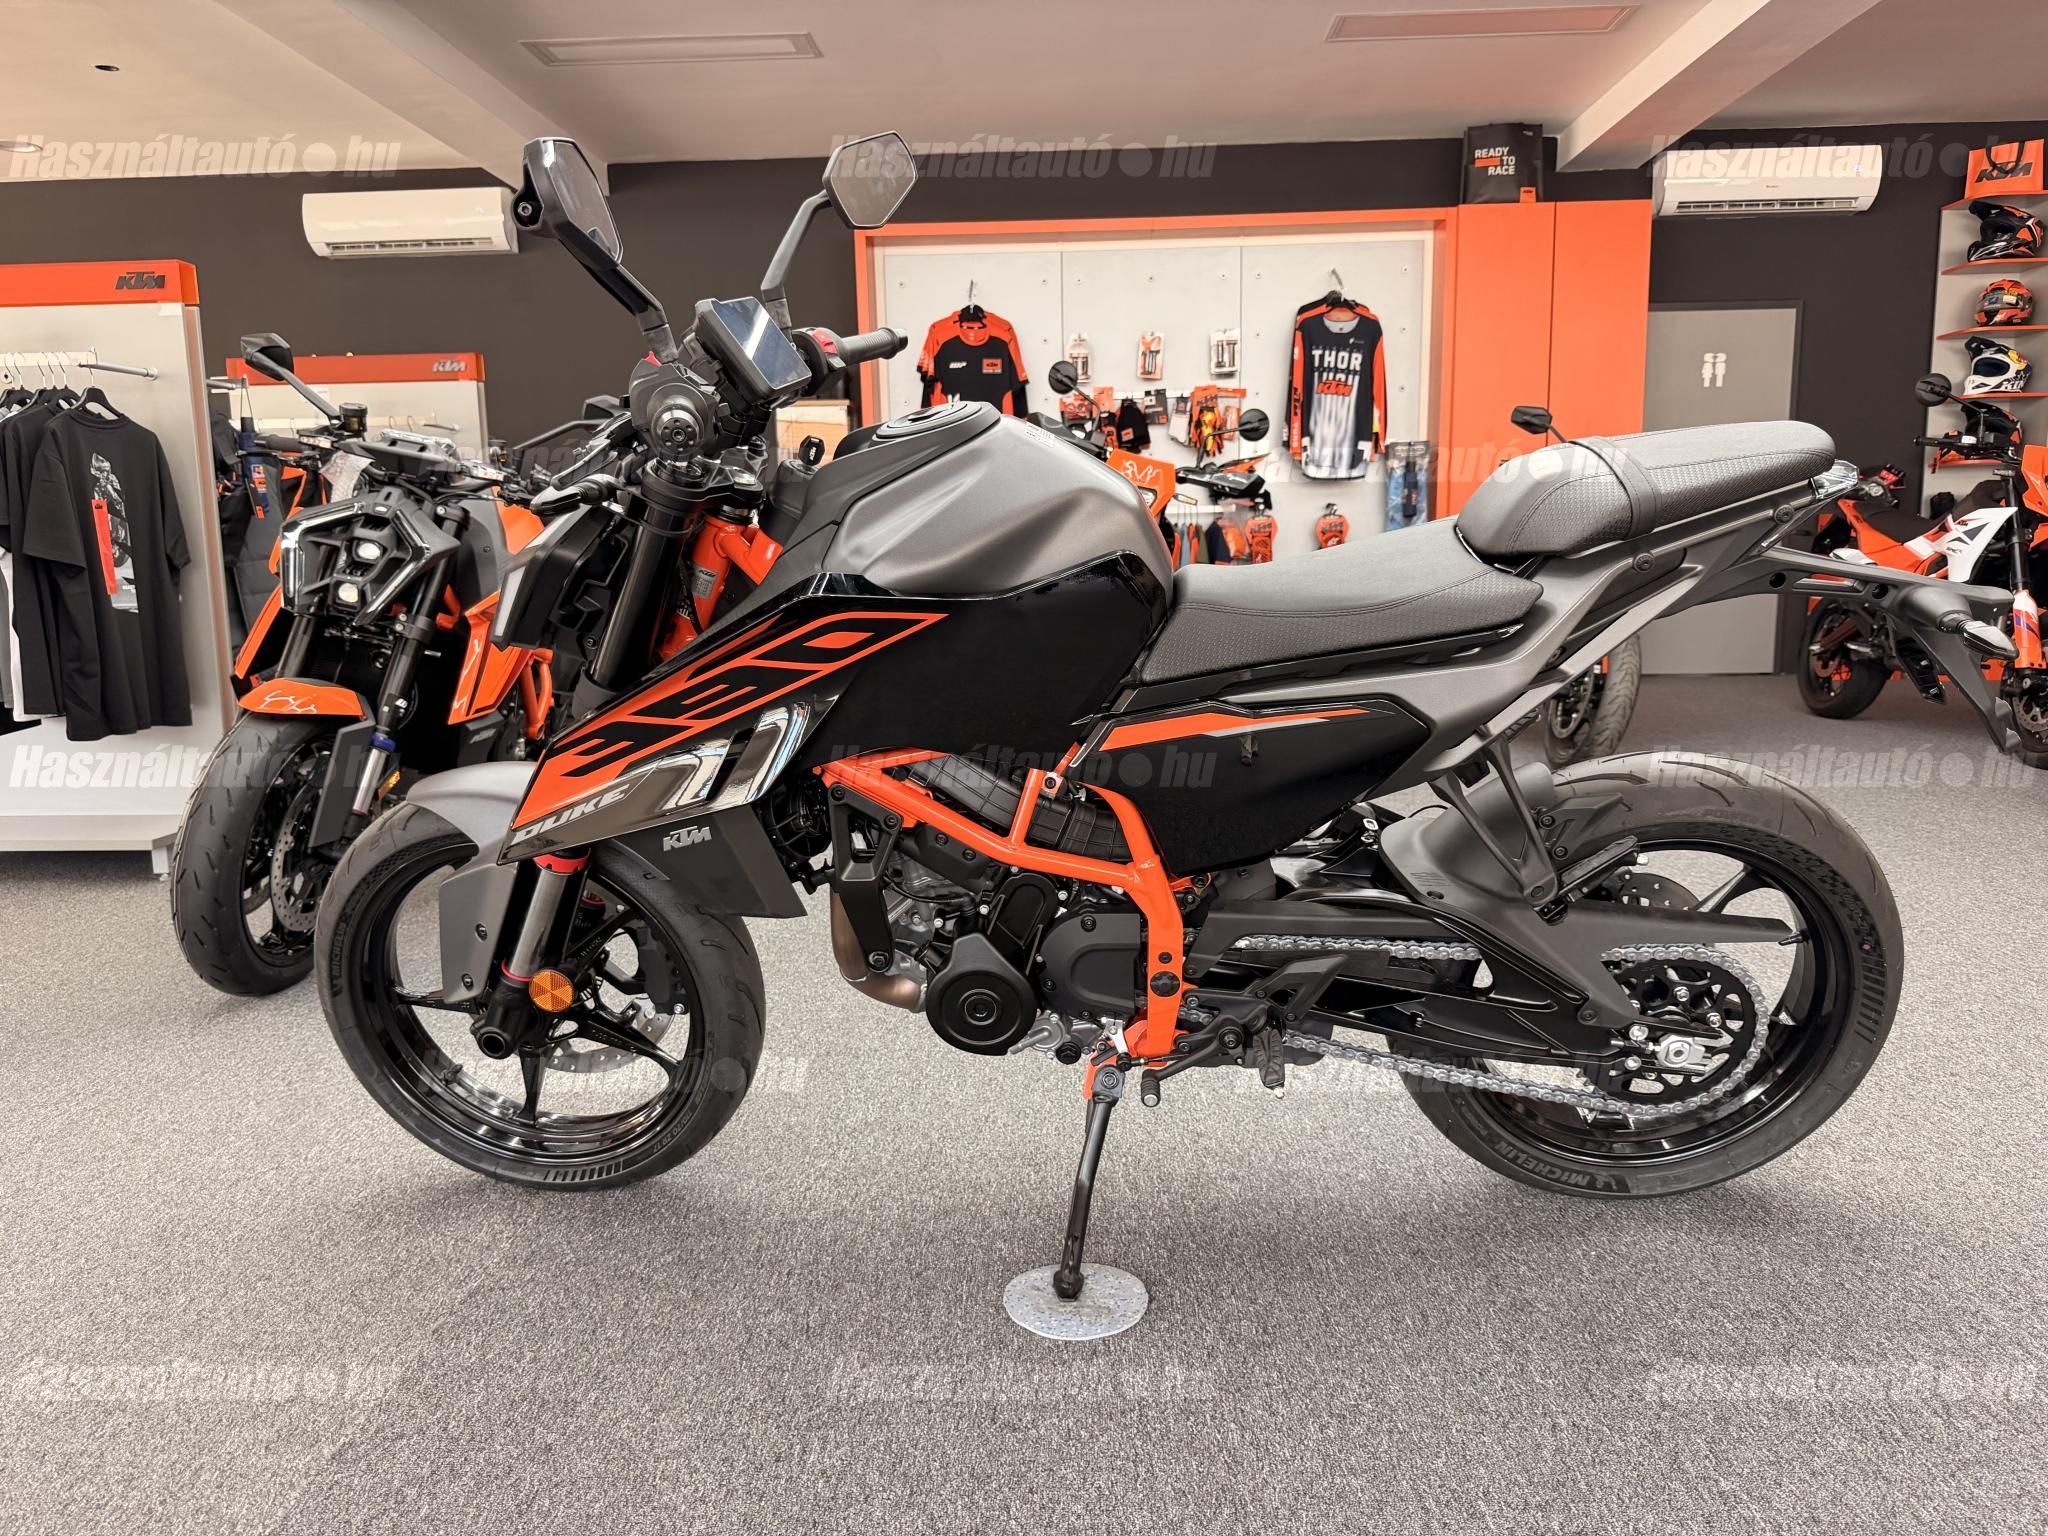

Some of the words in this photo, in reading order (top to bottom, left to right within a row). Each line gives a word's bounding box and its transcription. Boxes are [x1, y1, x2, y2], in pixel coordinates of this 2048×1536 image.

[1475, 147, 1509, 158] READY
[1502, 156, 1516, 165] TO
[1488, 166, 1516, 176] RACE
[115, 272, 165, 290] KTM
[432, 360, 467, 372] KTM
[1312, 349, 1363, 371] THOR
[1316, 380, 1354, 396] KTM
[511, 784, 630, 845] DUKE
[663, 826, 712, 851] KTM
[1494, 1141, 1591, 1187] MICHELIN
